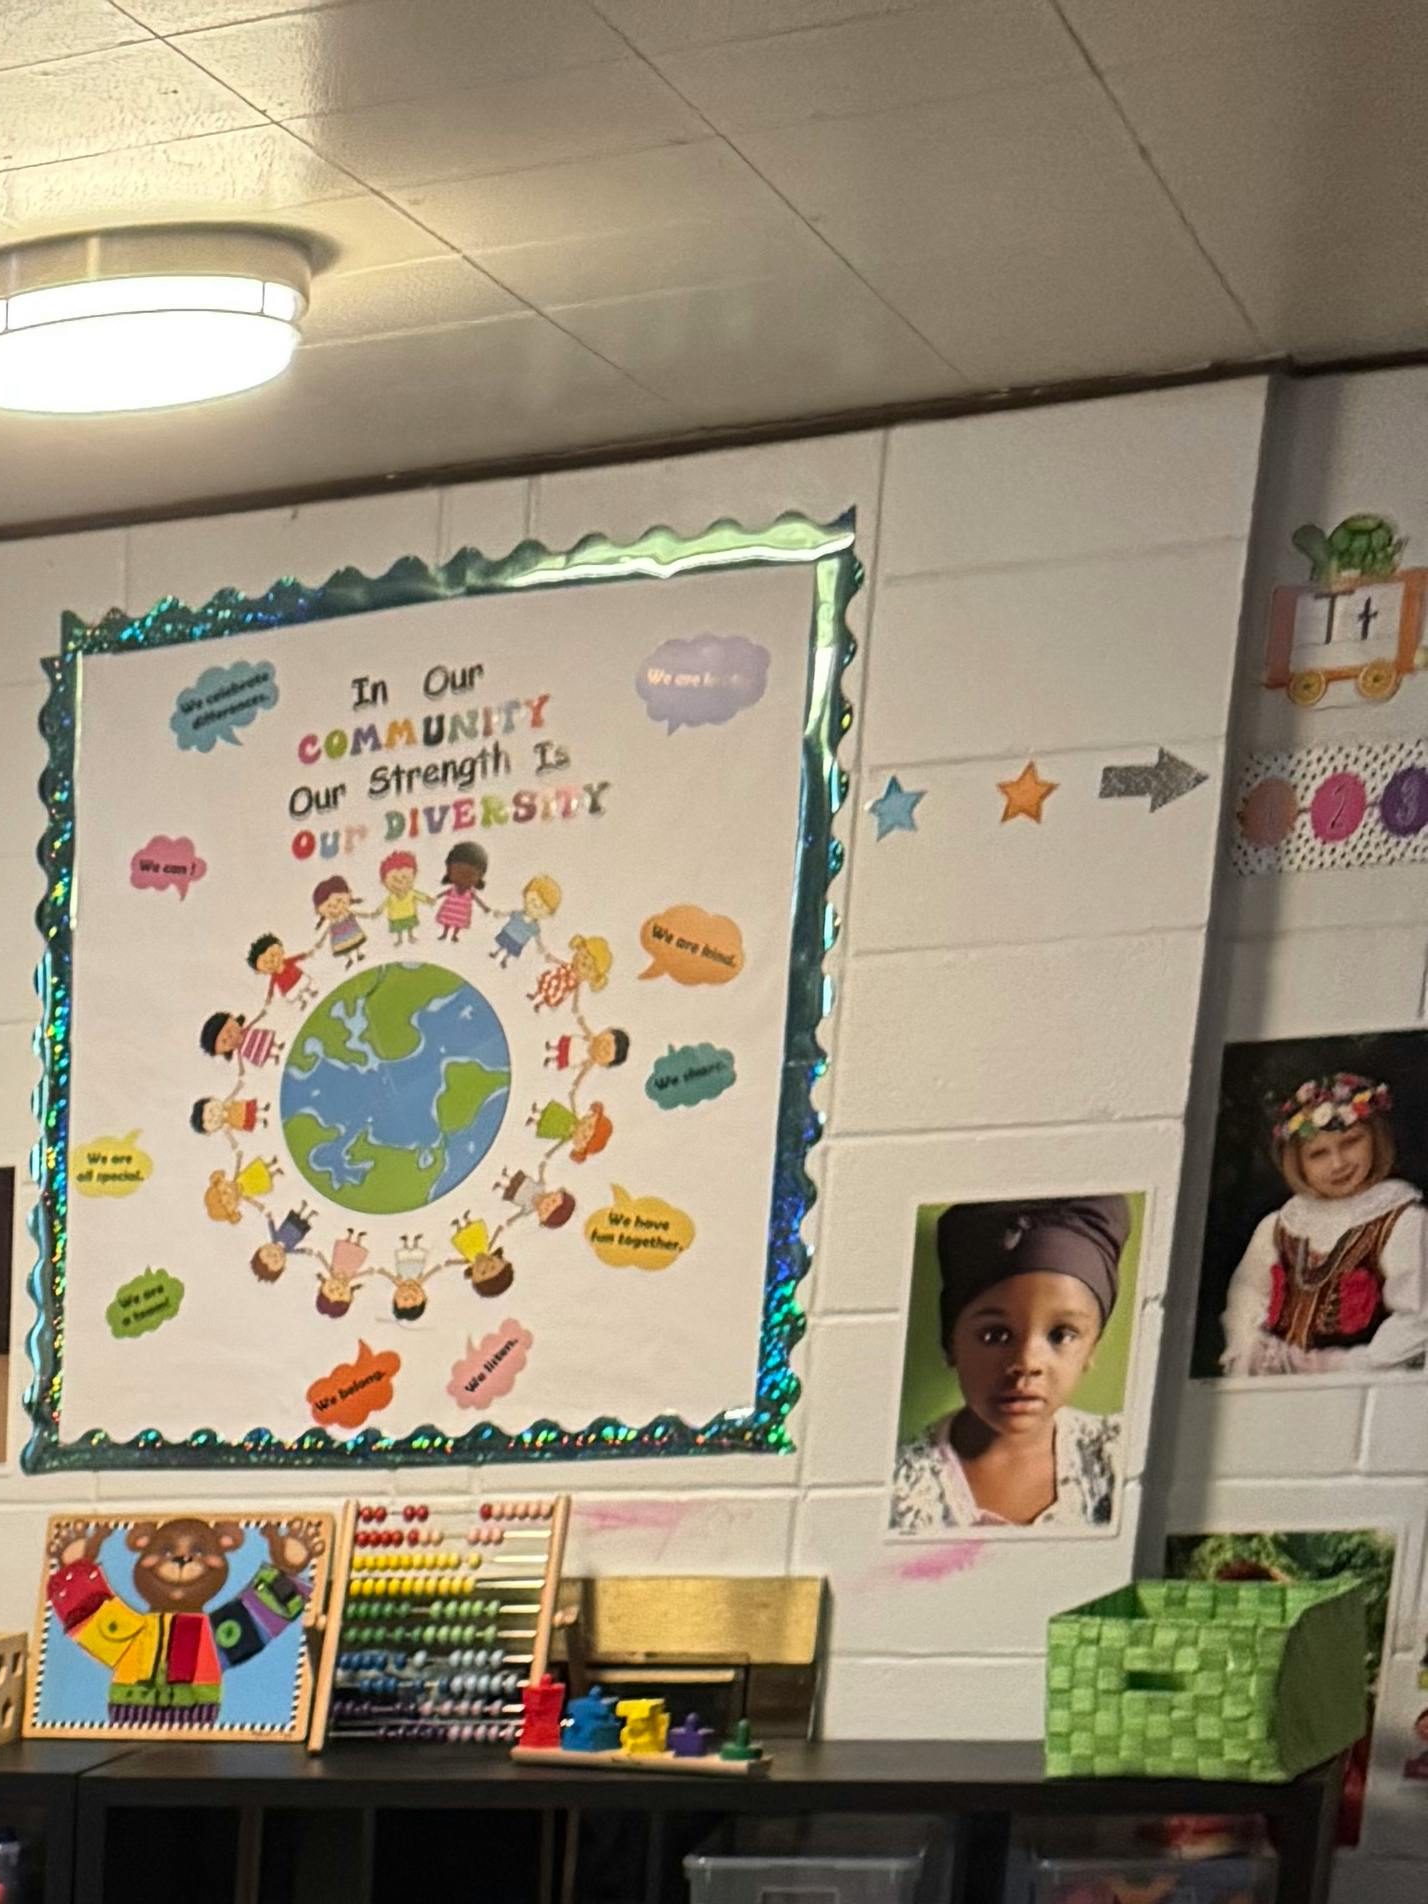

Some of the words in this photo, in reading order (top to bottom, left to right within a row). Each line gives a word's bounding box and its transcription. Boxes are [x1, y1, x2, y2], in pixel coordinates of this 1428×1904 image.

[351, 676, 388, 710] In
[423, 663, 483, 700] Our
[298, 693, 550, 764] COMMUNITY
[289, 783, 346, 819] Our
[368, 741, 511, 799] Strength
[534, 740, 570, 778] Is
[384, 780, 610, 841] DIVERSITY
[1330, 784, 1348, 830] 2
[139, 860, 160, 874] We
[652, 924, 674, 944] We
[675, 937, 701, 955] are
[653, 1075, 678, 1091] We
[87, 1153, 108, 1165] We
[111, 1153, 132, 1164] are
[77, 1170, 93, 1182] all
[96, 1170, 144, 1185] special.
[608, 1210, 631, 1228] We
[634, 1215, 670, 1231] have
[591, 1227, 614, 1242] fun
[618, 1233, 683, 1253] together.
[118, 1292, 139, 1308] We
[464, 1372, 486, 1393] We
[484, 1338, 518, 1373] listen.
[315, 1397, 336, 1412] We
[339, 1370, 386, 1399] belong.
